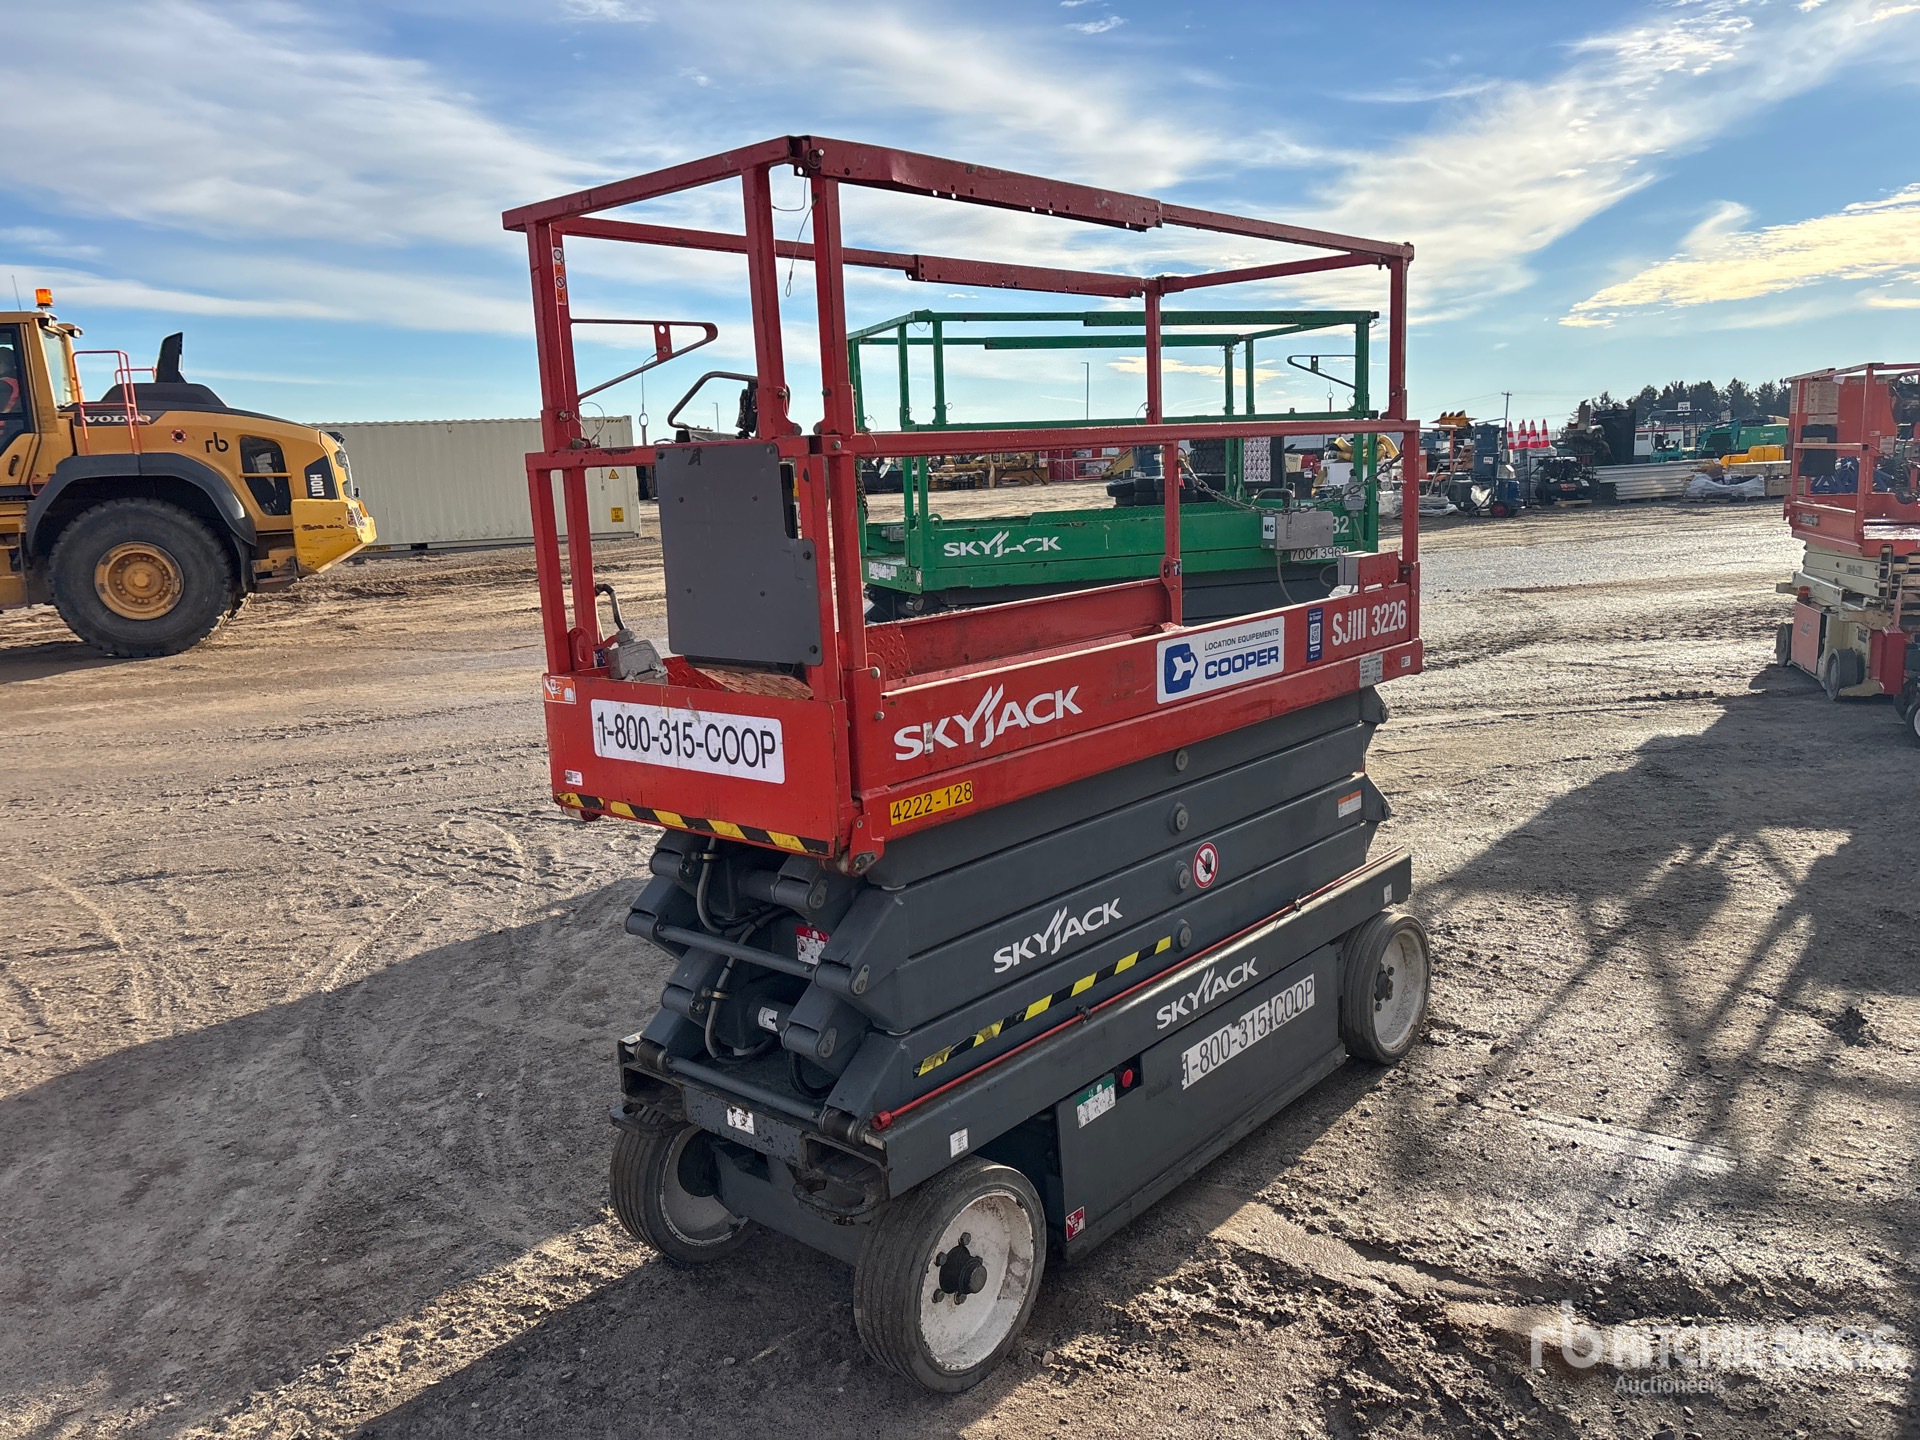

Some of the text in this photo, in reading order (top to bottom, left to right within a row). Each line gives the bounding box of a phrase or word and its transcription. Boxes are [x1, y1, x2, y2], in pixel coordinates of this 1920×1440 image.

[84, 414, 151, 424] VOLVO
[205, 431, 229, 453] rb
[1264, 524, 1274, 533] MC
[1371, 599, 1407, 636] 3226
[1204, 628, 1279, 651] LOCATION EQUIPEMENTS
[1204, 646, 1279, 680] COOPER
[598, 711, 776, 769] 1-800-315-COOP
[893, 683, 1083, 761] SKYJACK
[892, 782, 973, 822] 4222-128
[993, 897, 1123, 974] SKYJACK
[1156, 956, 1259, 1030] SKYJACK
